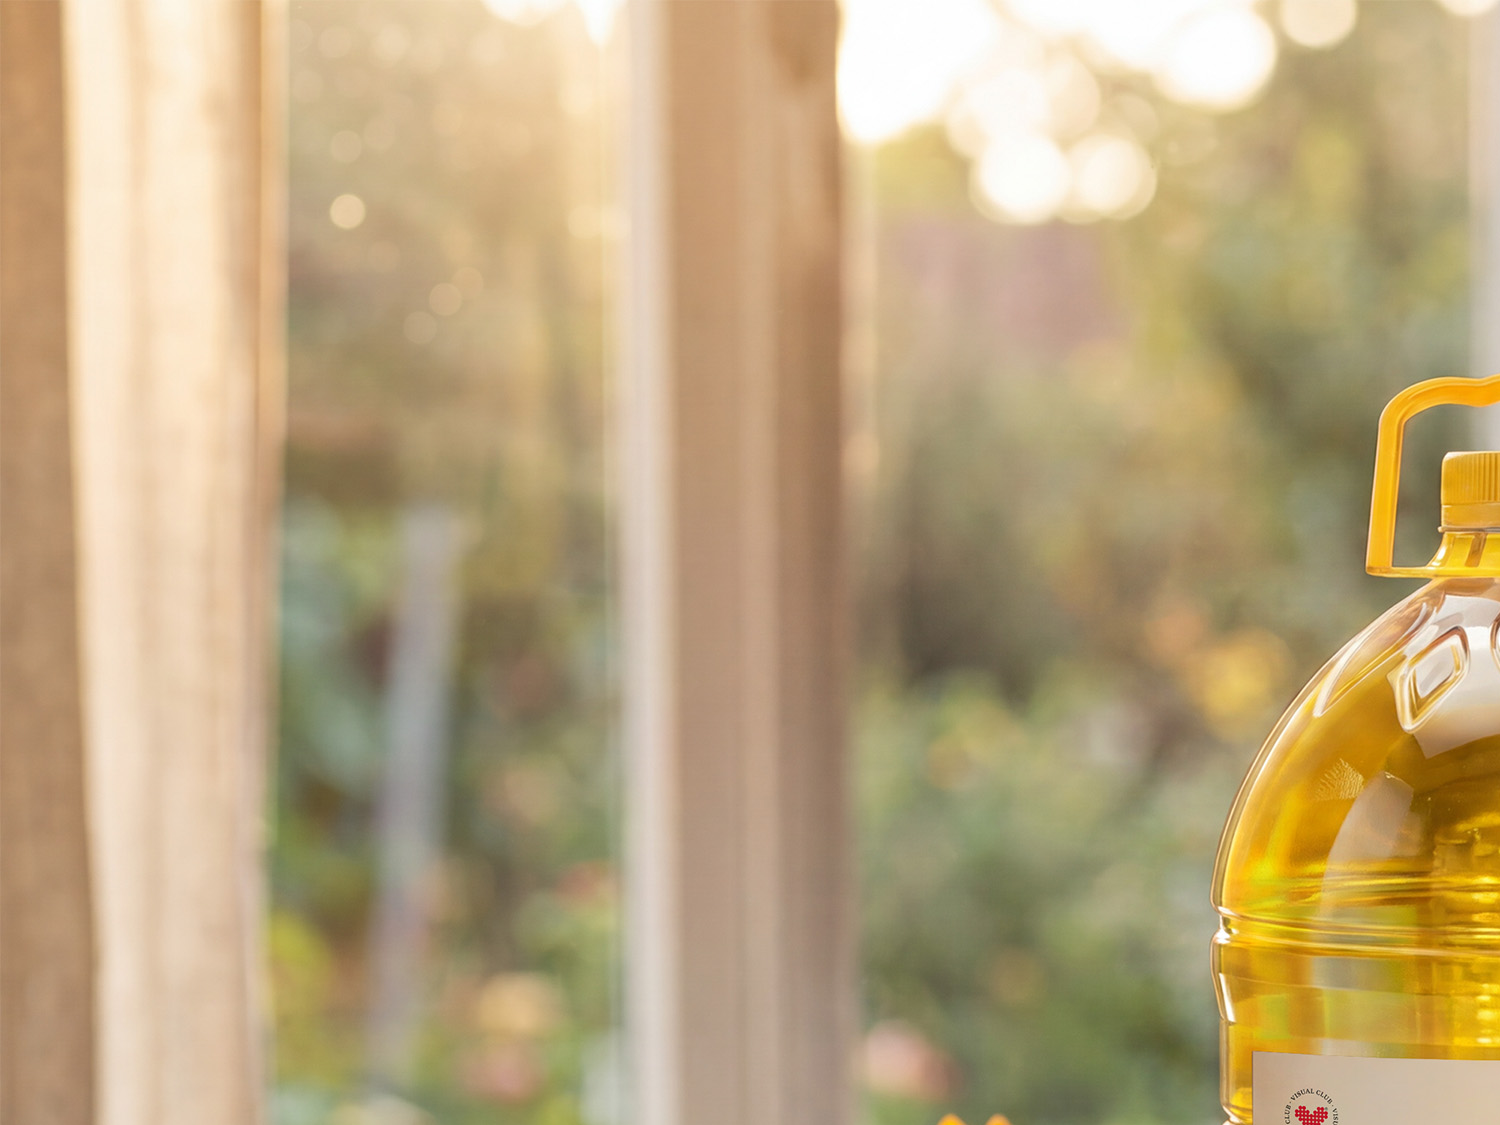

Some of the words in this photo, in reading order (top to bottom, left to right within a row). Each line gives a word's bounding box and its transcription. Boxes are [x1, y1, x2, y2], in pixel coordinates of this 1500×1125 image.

[1290, 1088, 1315, 1101] VISUAL
[1316, 1089, 1333, 1104] CLUB
[1284, 1104, 1292, 1125] CLUB
